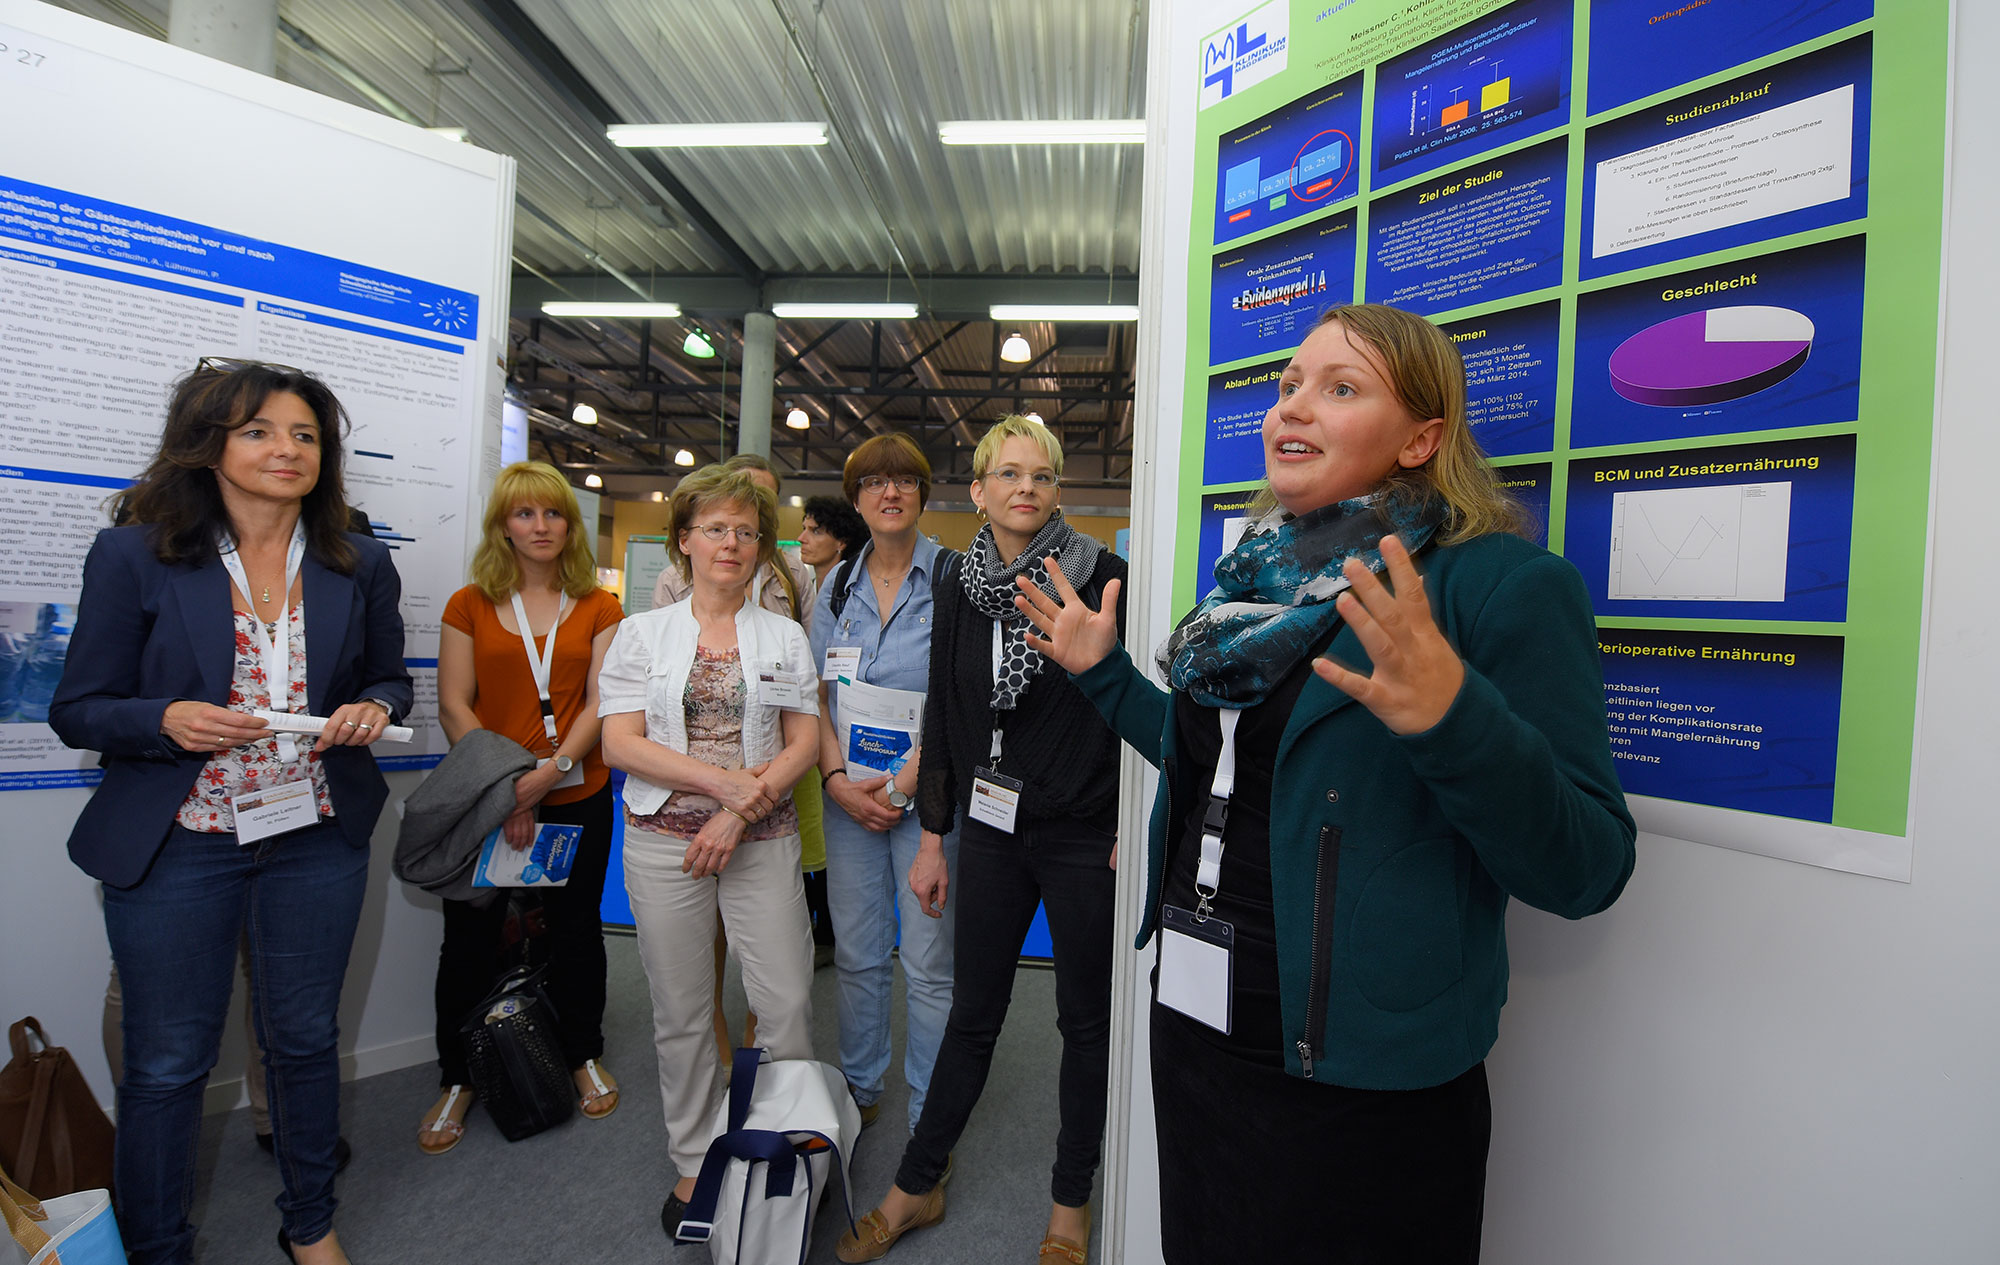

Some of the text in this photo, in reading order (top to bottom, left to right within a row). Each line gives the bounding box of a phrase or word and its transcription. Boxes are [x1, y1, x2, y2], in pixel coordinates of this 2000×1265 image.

[1350, 19, 1388, 42] Meissner
[1396, 28, 1429, 50] Klinikum
[1346, 30, 1386, 55] Magdeburg
[1431, 21, 1509, 61] DGEM-Multicenterstudie
[17, 49, 46, 67] 27
[1235, 37, 1286, 68] KLINIKUM
[1235, 45, 1286, 73] MAGDEBURG
[1665, 81, 1771, 126] Studienablauf
[1418, 169, 1503, 204] Ziel der Studie
[1246, 252, 1313, 277] Orale Zusatznahrung
[1258, 265, 1301, 283] Trinknahrung
[1242, 274, 1309, 311] Evidenzgrad
[1317, 268, 1327, 292] A
[1661, 273, 1758, 302] Geschlecht
[1461, 343, 1525, 360] einschließlich der
[1501, 352, 1529, 362] Monate
[1479, 366, 1494, 375] sich
[1507, 360, 1541, 370] Zeitraum
[1224, 376, 1250, 389] Ablauf
[1252, 372, 1268, 384] und
[1466, 370, 1530, 386] Ende März 2014.
[1483, 392, 1523, 404] 100% (102
[1489, 400, 1537, 413] und 75% (77
[1489, 410, 1528, 422] untersucht
[1594, 456, 1819, 482] BCM und Zusatzernährung
[1701, 647, 1795, 666] Ernährung
[1656, 700, 1691, 712] liegen
[1695, 705, 1715, 713] vor
[1627, 711, 1762, 733] der Komplikationsrate
[1629, 727, 1760, 750] mit Mangelernährung
[863, 746, 898, 756] SYMPOSIUM
[1610, 750, 1660, 763] relevanz
